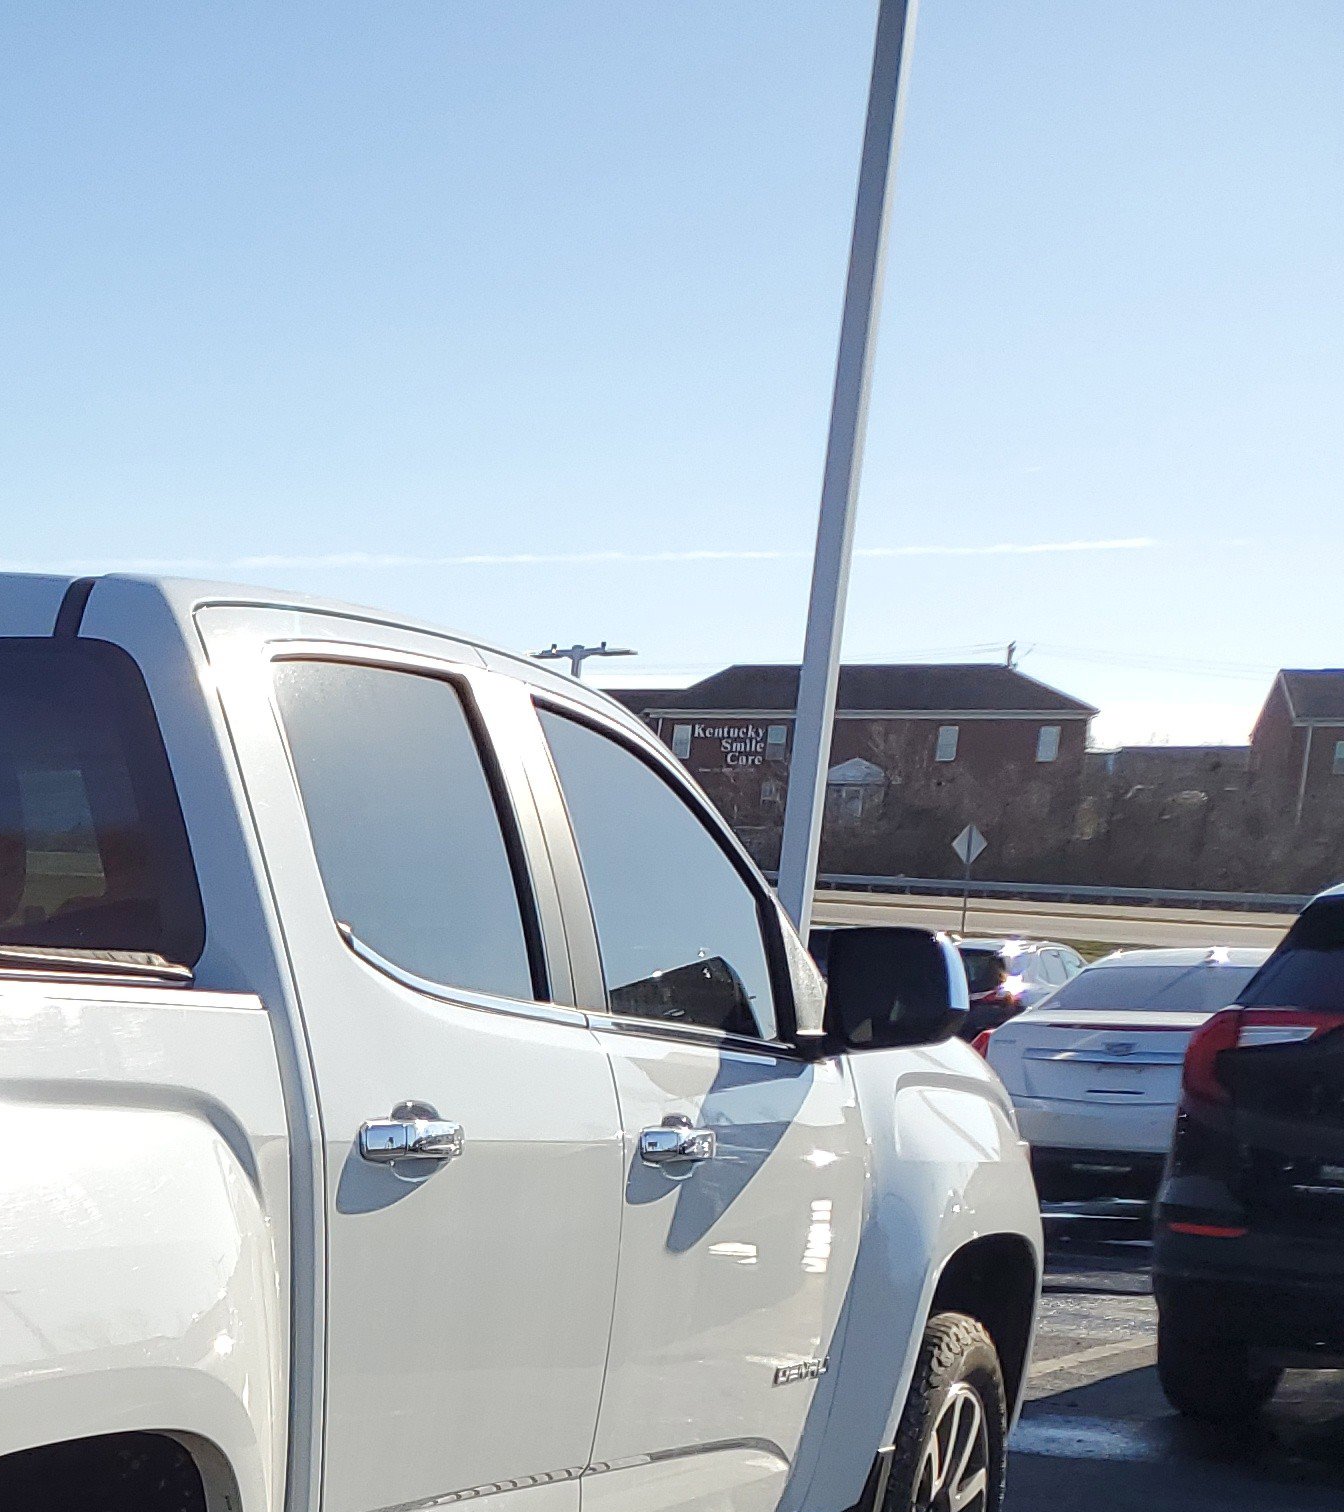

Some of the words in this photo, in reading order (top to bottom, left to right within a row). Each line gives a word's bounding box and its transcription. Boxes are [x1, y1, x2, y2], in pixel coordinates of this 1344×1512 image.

[693, 723, 766, 741] Kentucky
[720, 738, 765, 752] Smile
[726, 752, 764, 765] Care
